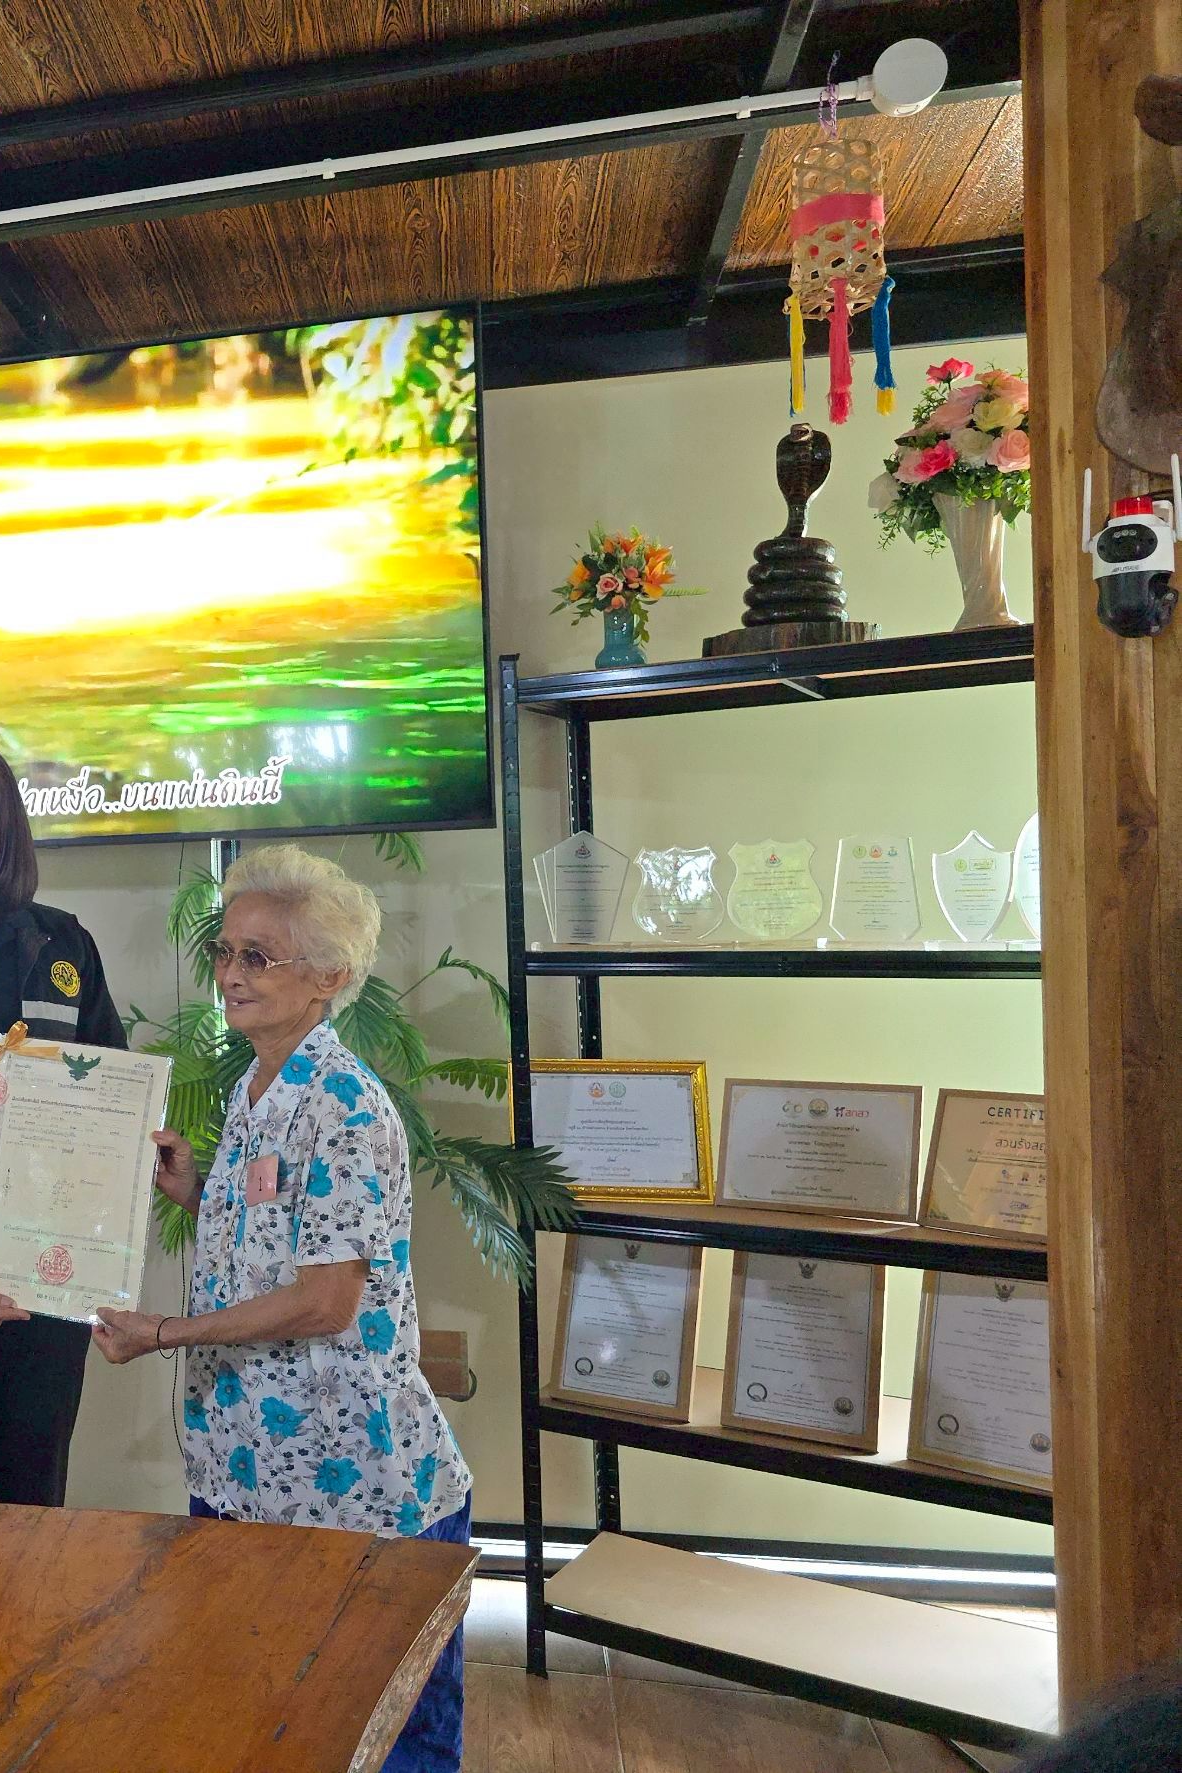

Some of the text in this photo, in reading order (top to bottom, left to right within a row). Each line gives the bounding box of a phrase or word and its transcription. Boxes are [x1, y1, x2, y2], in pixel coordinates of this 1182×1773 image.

[19, 756, 292, 815] ่าเหงื่อ..บนแผ่นดินนี้
